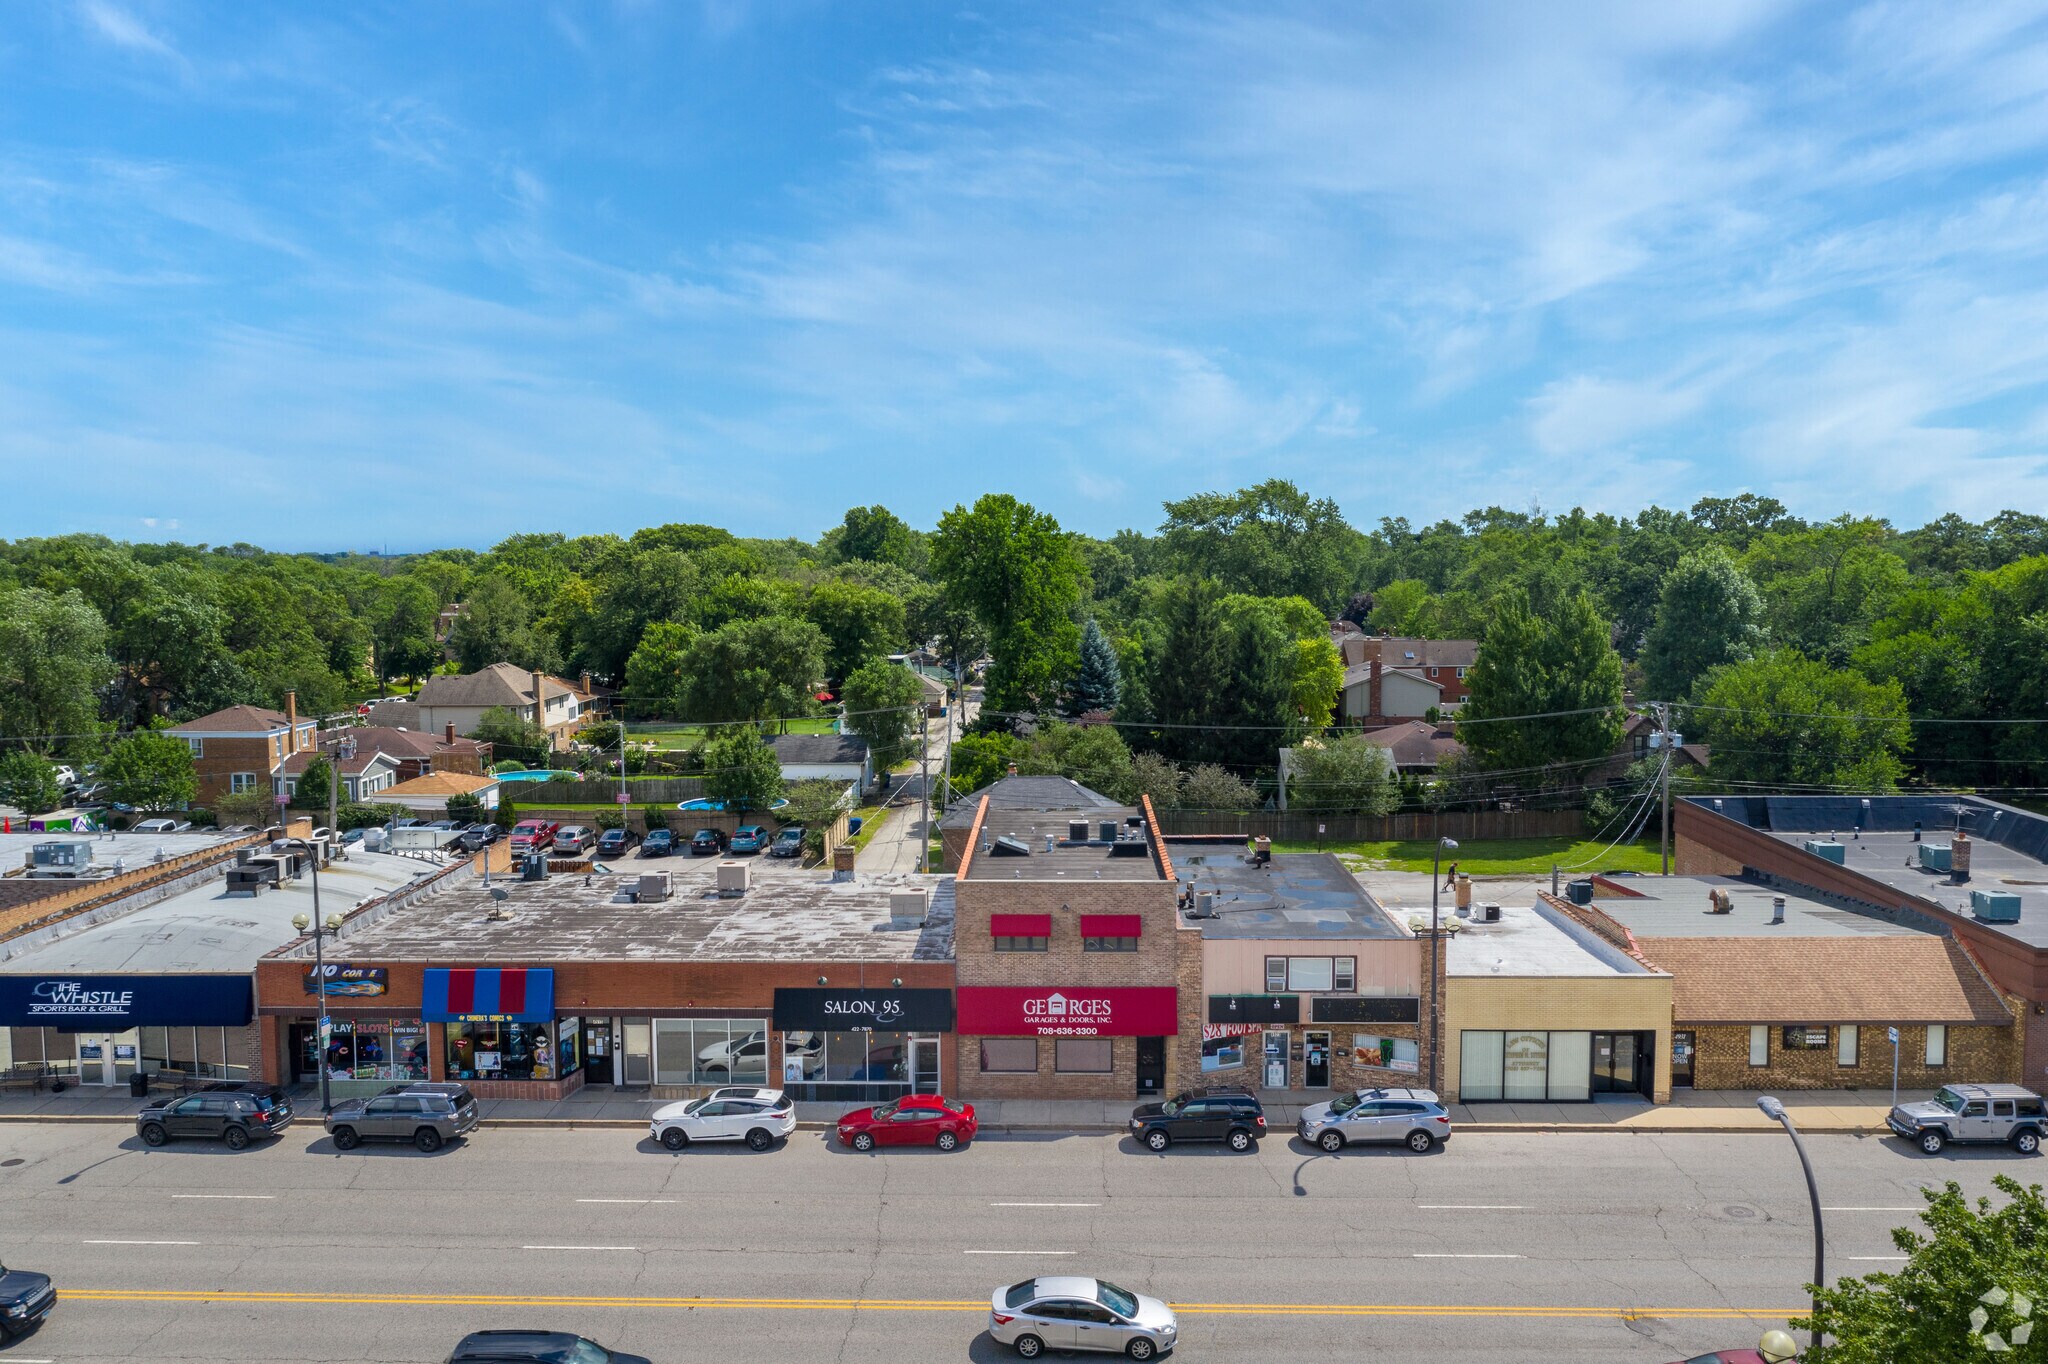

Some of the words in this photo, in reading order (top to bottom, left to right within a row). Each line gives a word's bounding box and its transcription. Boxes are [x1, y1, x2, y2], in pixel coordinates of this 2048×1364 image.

[57, 982, 82, 992] THE
[51, 991, 133, 1004] WHISTLE
[824, 1000, 876, 1014] SALON
[883, 1000, 901, 1014] 95
[1068, 1016, 1096, 1024] DOORS,
[328, 1023, 353, 1033] PLAY
[356, 1023, 390, 1034] SLOTS
[1037, 1027, 1098, 1035] 708-636-3300
